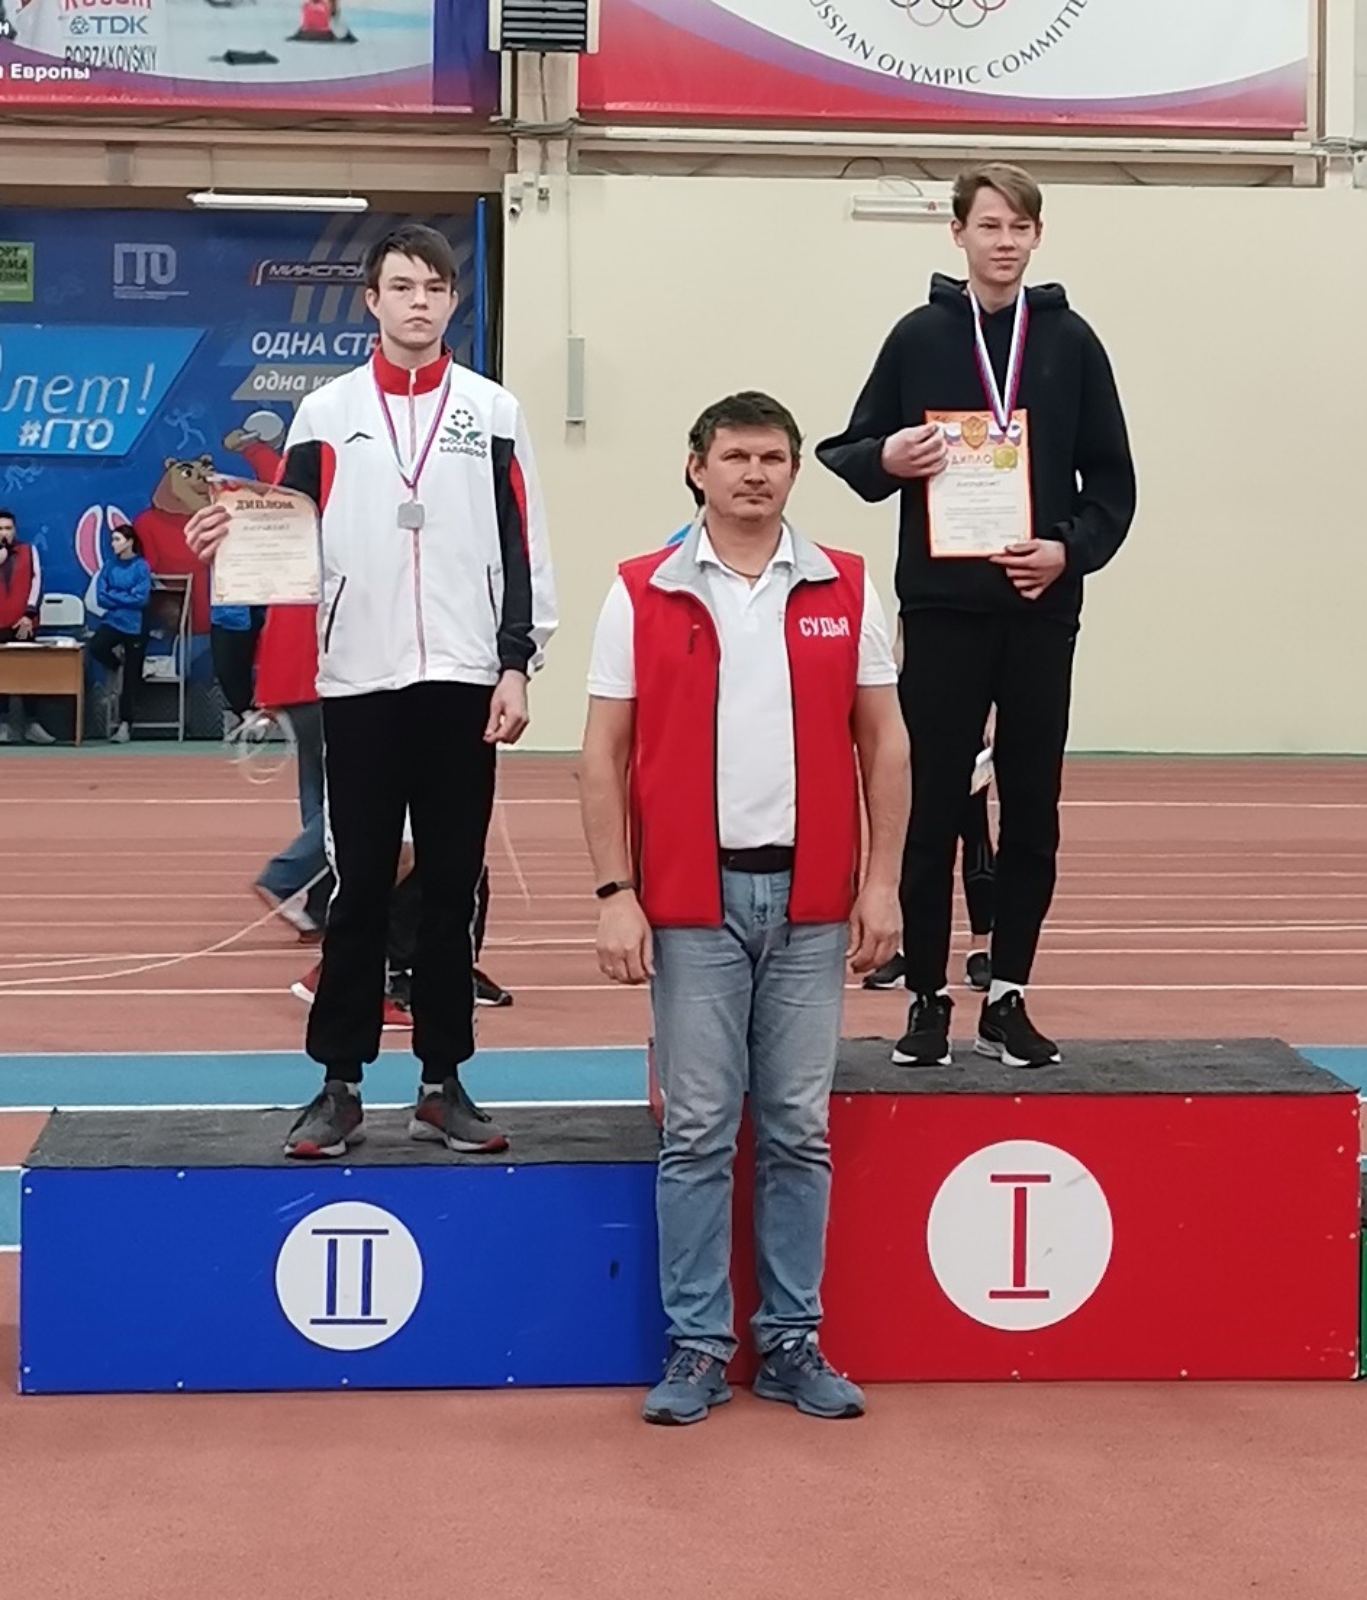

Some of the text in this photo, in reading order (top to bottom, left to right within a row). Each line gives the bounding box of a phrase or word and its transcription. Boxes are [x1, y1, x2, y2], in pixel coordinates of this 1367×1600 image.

[89, 15, 148, 34] TDK
[10, 63, 91, 82] Европы
[877, 53, 981, 84] OLYMPIC
[251, 331, 327, 359] ОДНА
[1, 362, 156, 415] лет!
[253, 370, 306, 391] одна
[18, 417, 114, 450] #ГТО
[951, 454, 993, 465] ДИПЛО
[235, 499, 295, 511] ДИПЛОМ
[799, 615, 850, 637] СУДЬЯ
